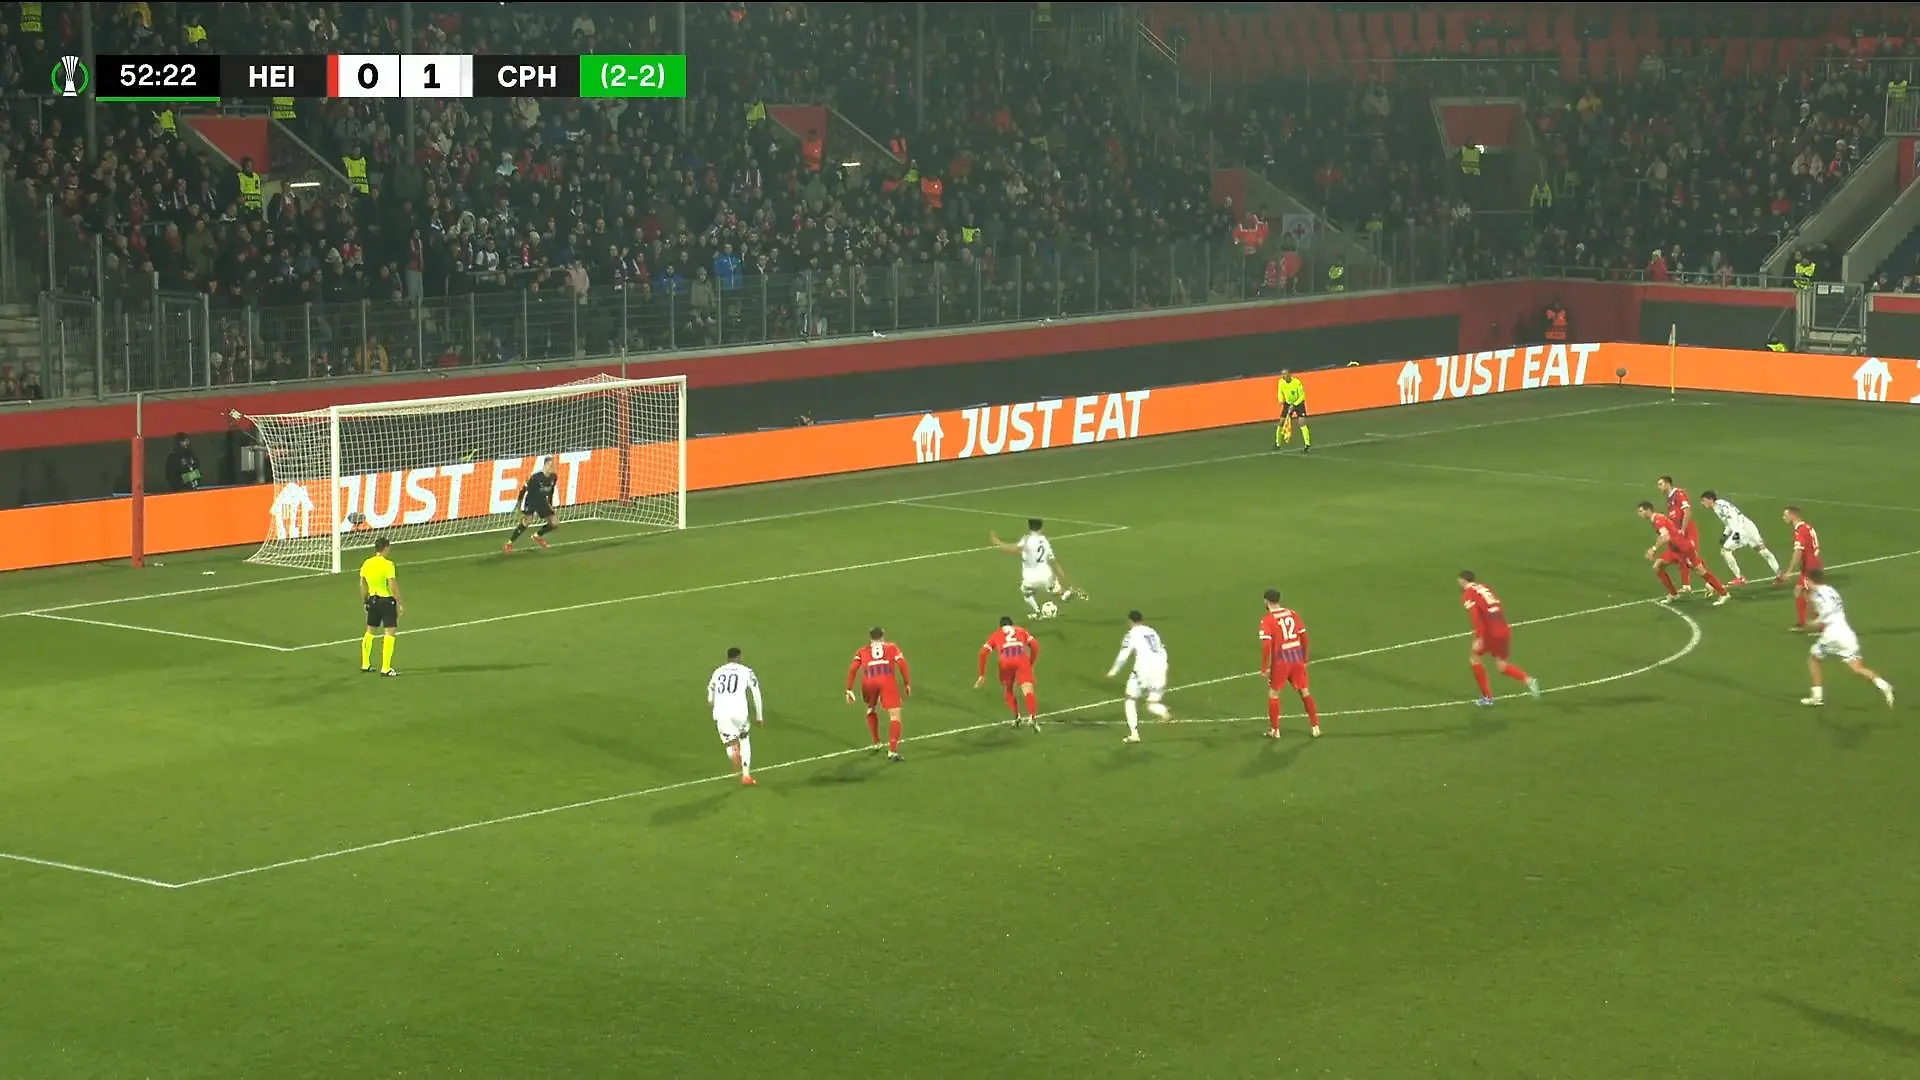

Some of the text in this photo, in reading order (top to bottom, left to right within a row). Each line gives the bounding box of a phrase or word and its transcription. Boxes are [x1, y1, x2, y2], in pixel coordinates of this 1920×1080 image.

[1433, 343, 1600, 400] JUST EAT
[958, 390, 1150, 458] JUST EAT
[340, 463, 475, 532] JUST
[1036, 545, 1045, 563] 2
[1003, 626, 1017, 642] 2
[1277, 616, 1297, 640] 12
[717, 673, 738, 694] 30
